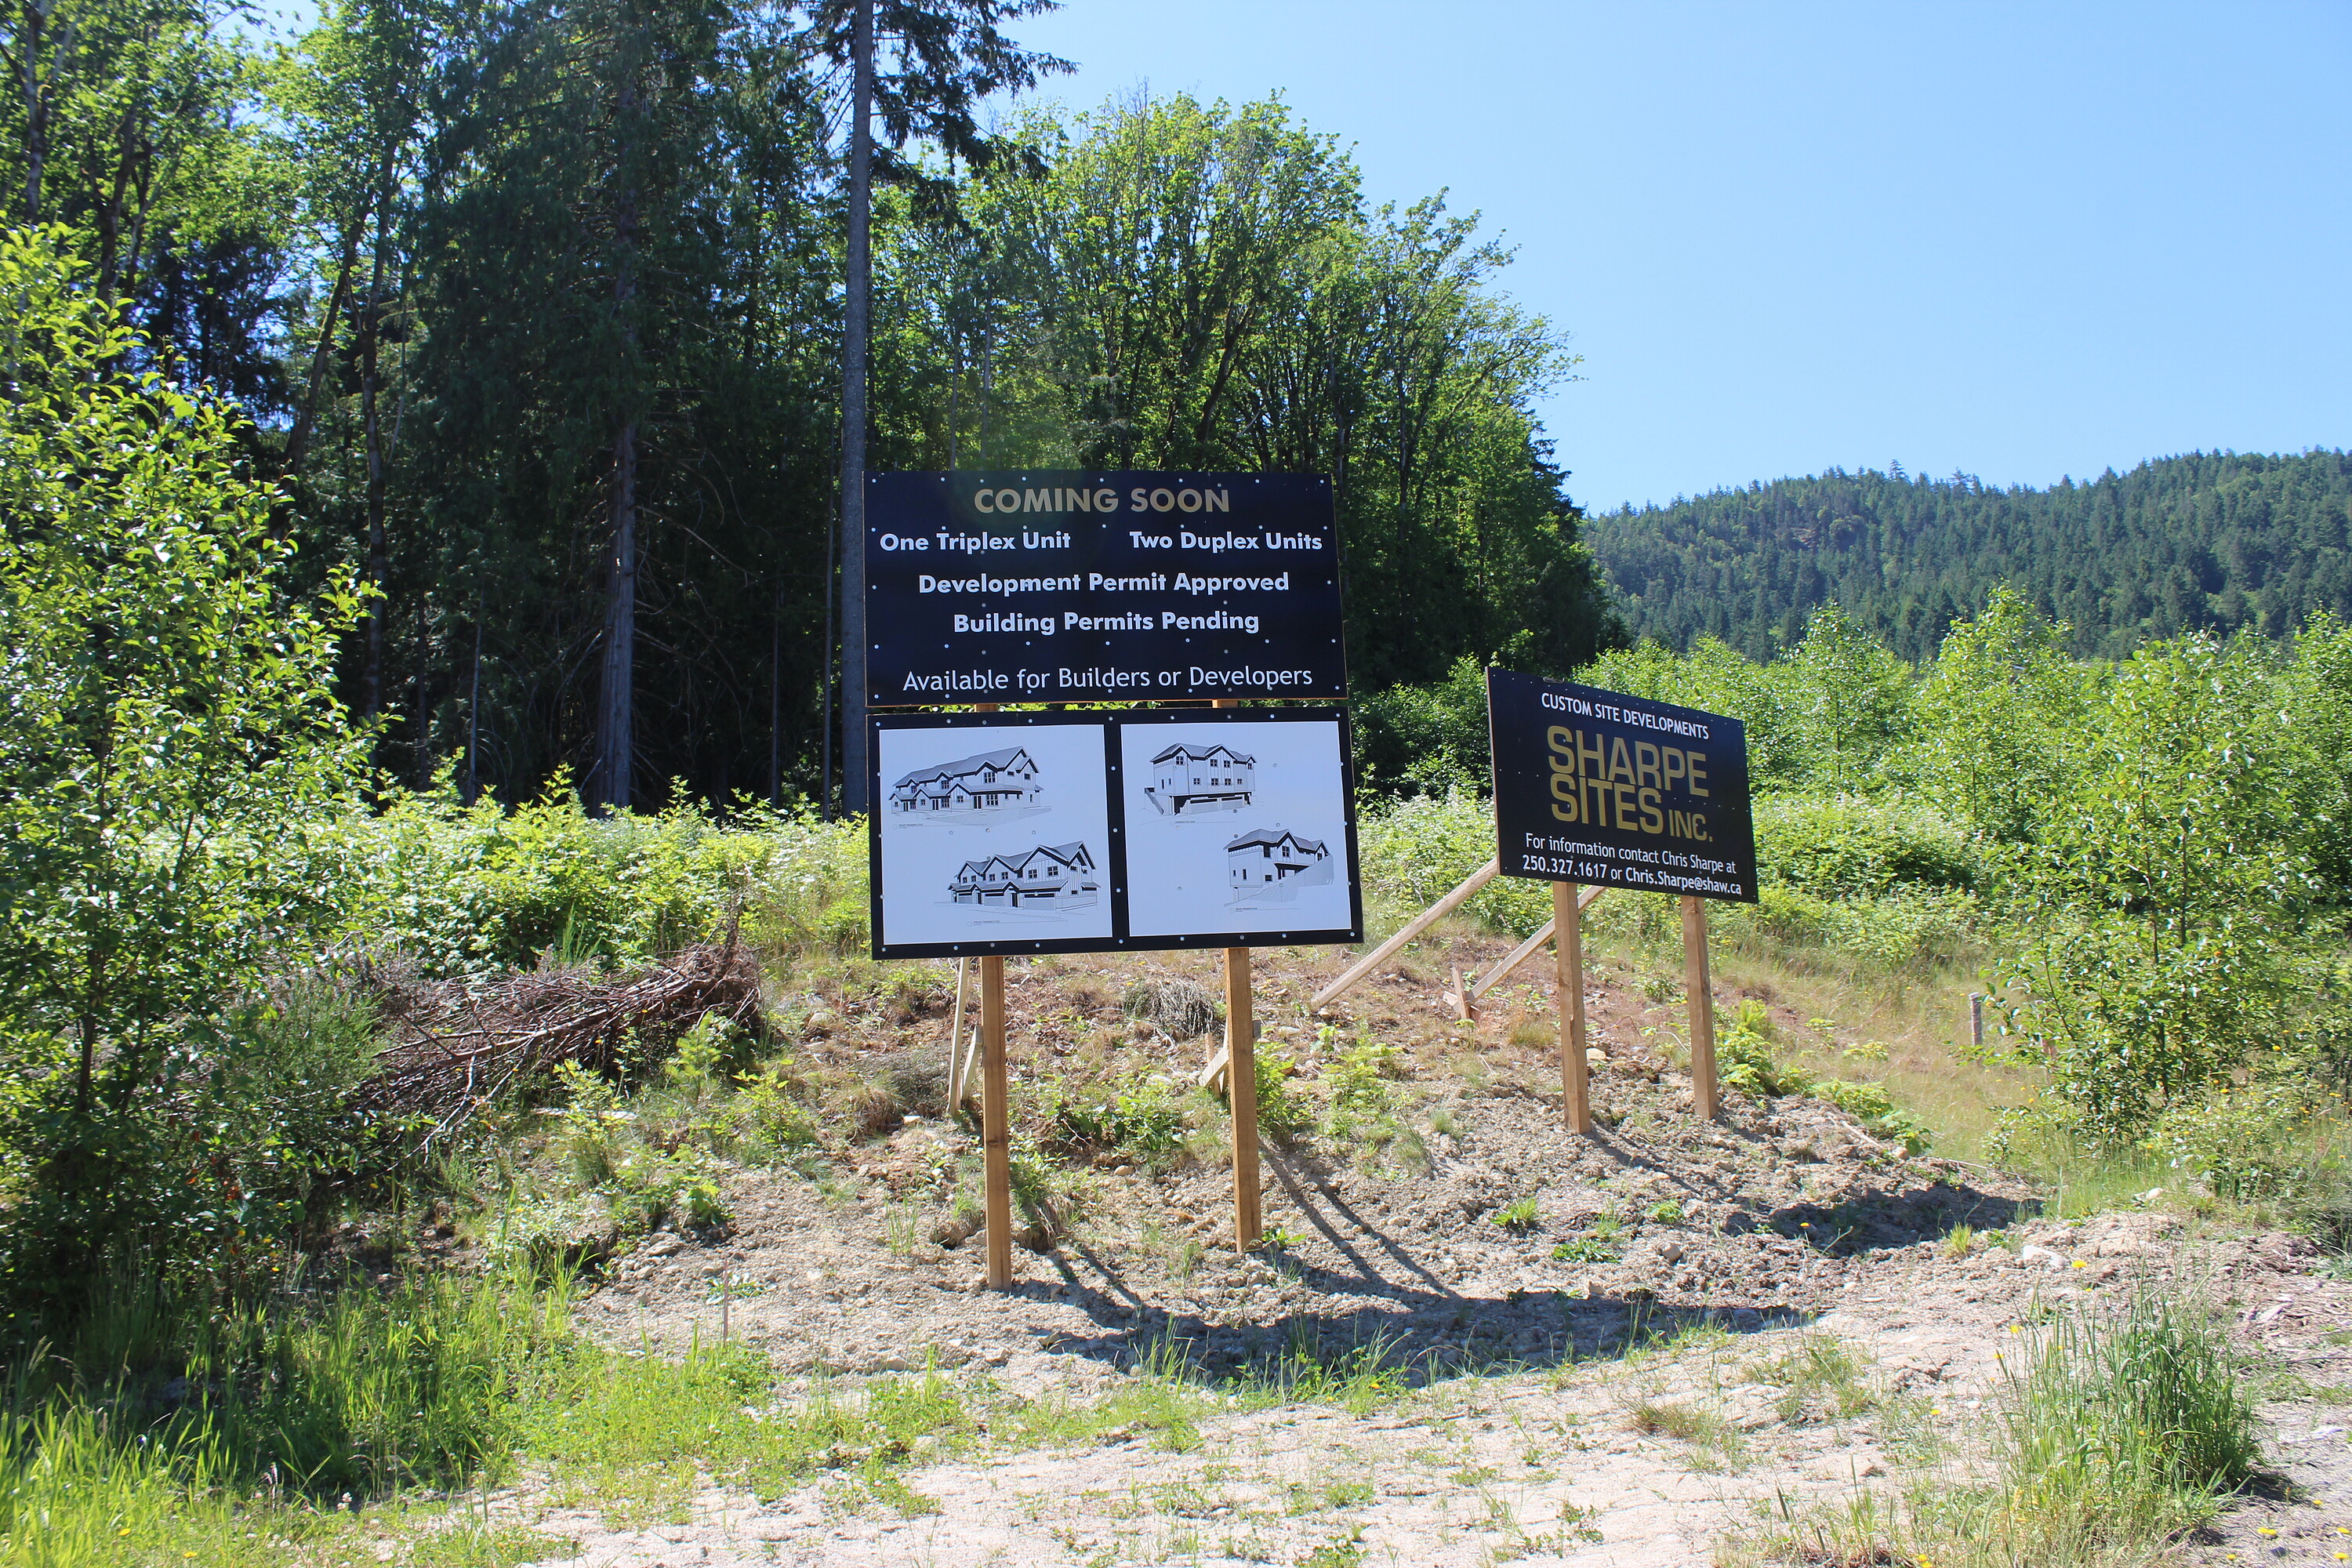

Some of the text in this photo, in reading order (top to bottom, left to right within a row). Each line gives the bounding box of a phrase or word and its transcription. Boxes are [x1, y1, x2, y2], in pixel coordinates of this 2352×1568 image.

[974, 488, 1230, 514] COMING SOON
[880, 530, 1071, 554] One Triplex Unit
[1130, 531, 1323, 554] Two Duplex Units
[919, 572, 1290, 597] Development Permit Approved
[954, 611, 1259, 636] Building Permits Pending
[902, 666, 1313, 691] Available for Builders or Developers
[1541, 692, 1709, 740] CUSTOM SITE DEVELOPMENTS
[1547, 725, 1709, 797] SHARPE
[1550, 773, 1713, 842] SITES INC.
[1526, 833, 1737, 875] For information contact Chris Sharpe at
[1522, 854, 1742, 895] 250.327.1617 or Chris.Sharpe@shaw.ca
